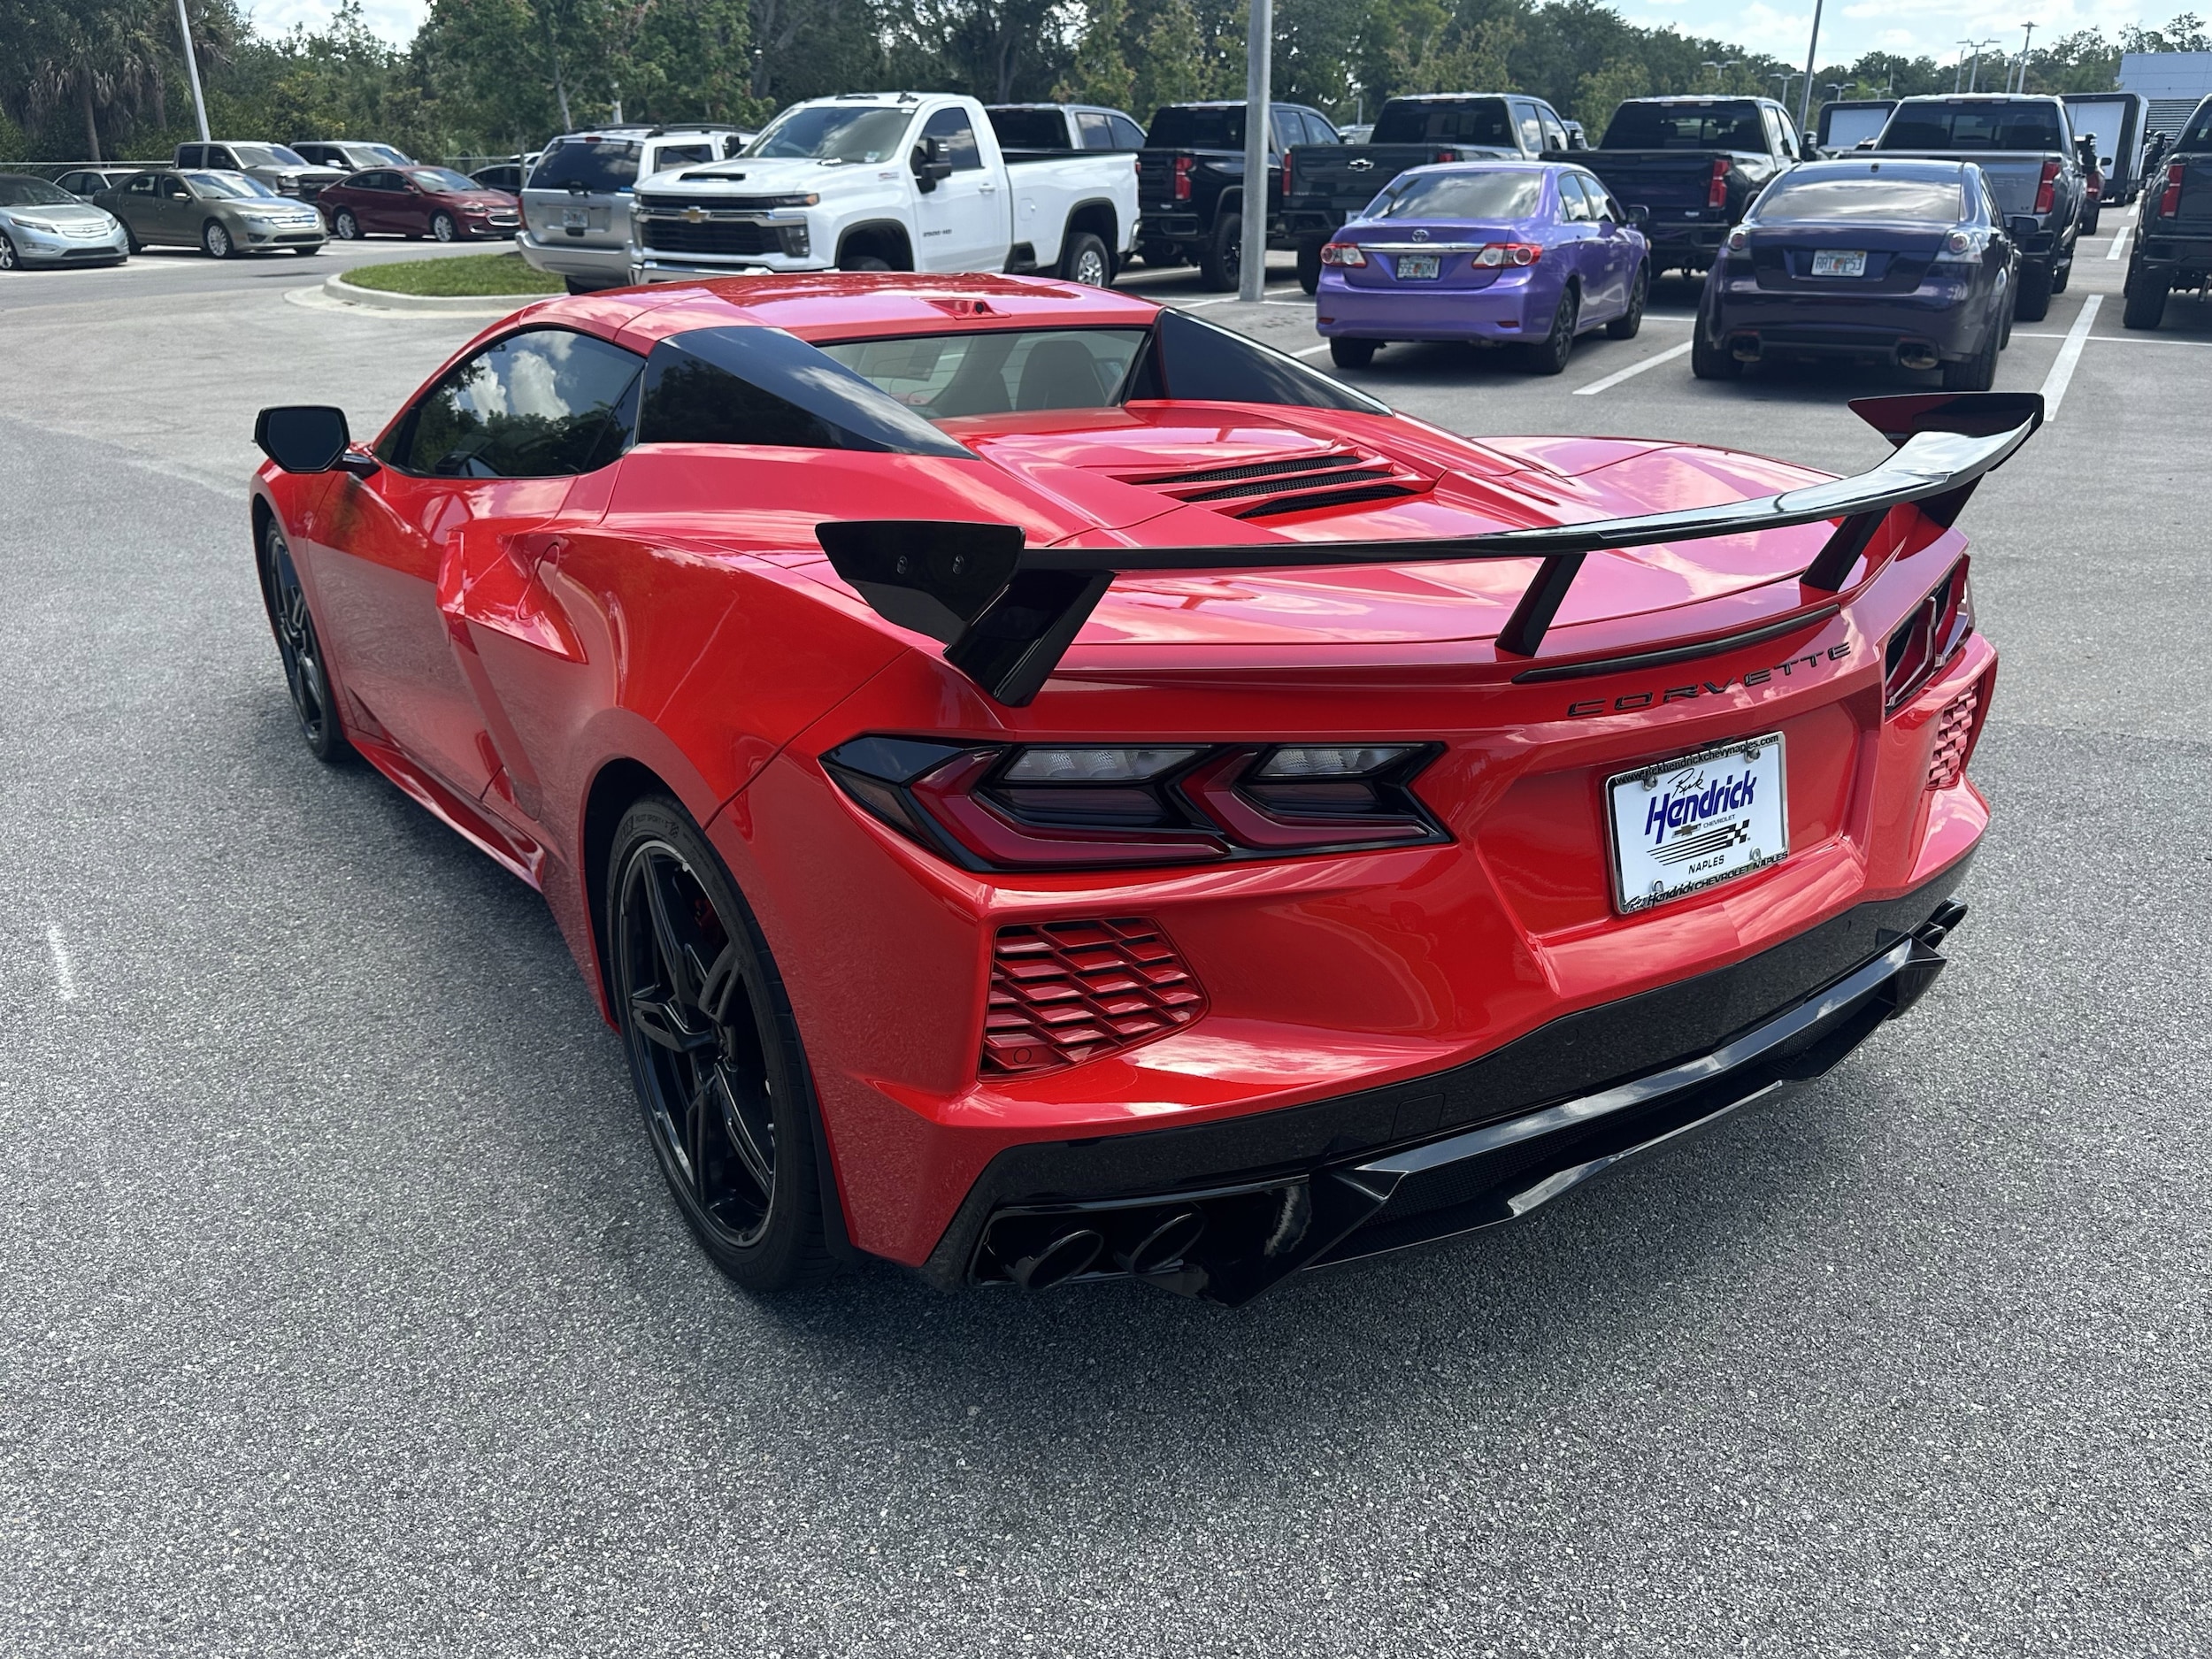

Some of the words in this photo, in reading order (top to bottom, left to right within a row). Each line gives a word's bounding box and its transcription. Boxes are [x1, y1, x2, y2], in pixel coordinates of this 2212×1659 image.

[1567, 641, 1852, 717] CORVETTE
[1667, 767, 1704, 798] Rick
[1644, 770, 1757, 845] Hendrick
[1703, 814, 1736, 829] CHEVROLET
[1647, 879, 1694, 909] Hendrick
[1694, 864, 1751, 890] CHEVROLET
[1753, 850, 1788, 869] NAPLES
[1688, 855, 1724, 874] NAPLES
